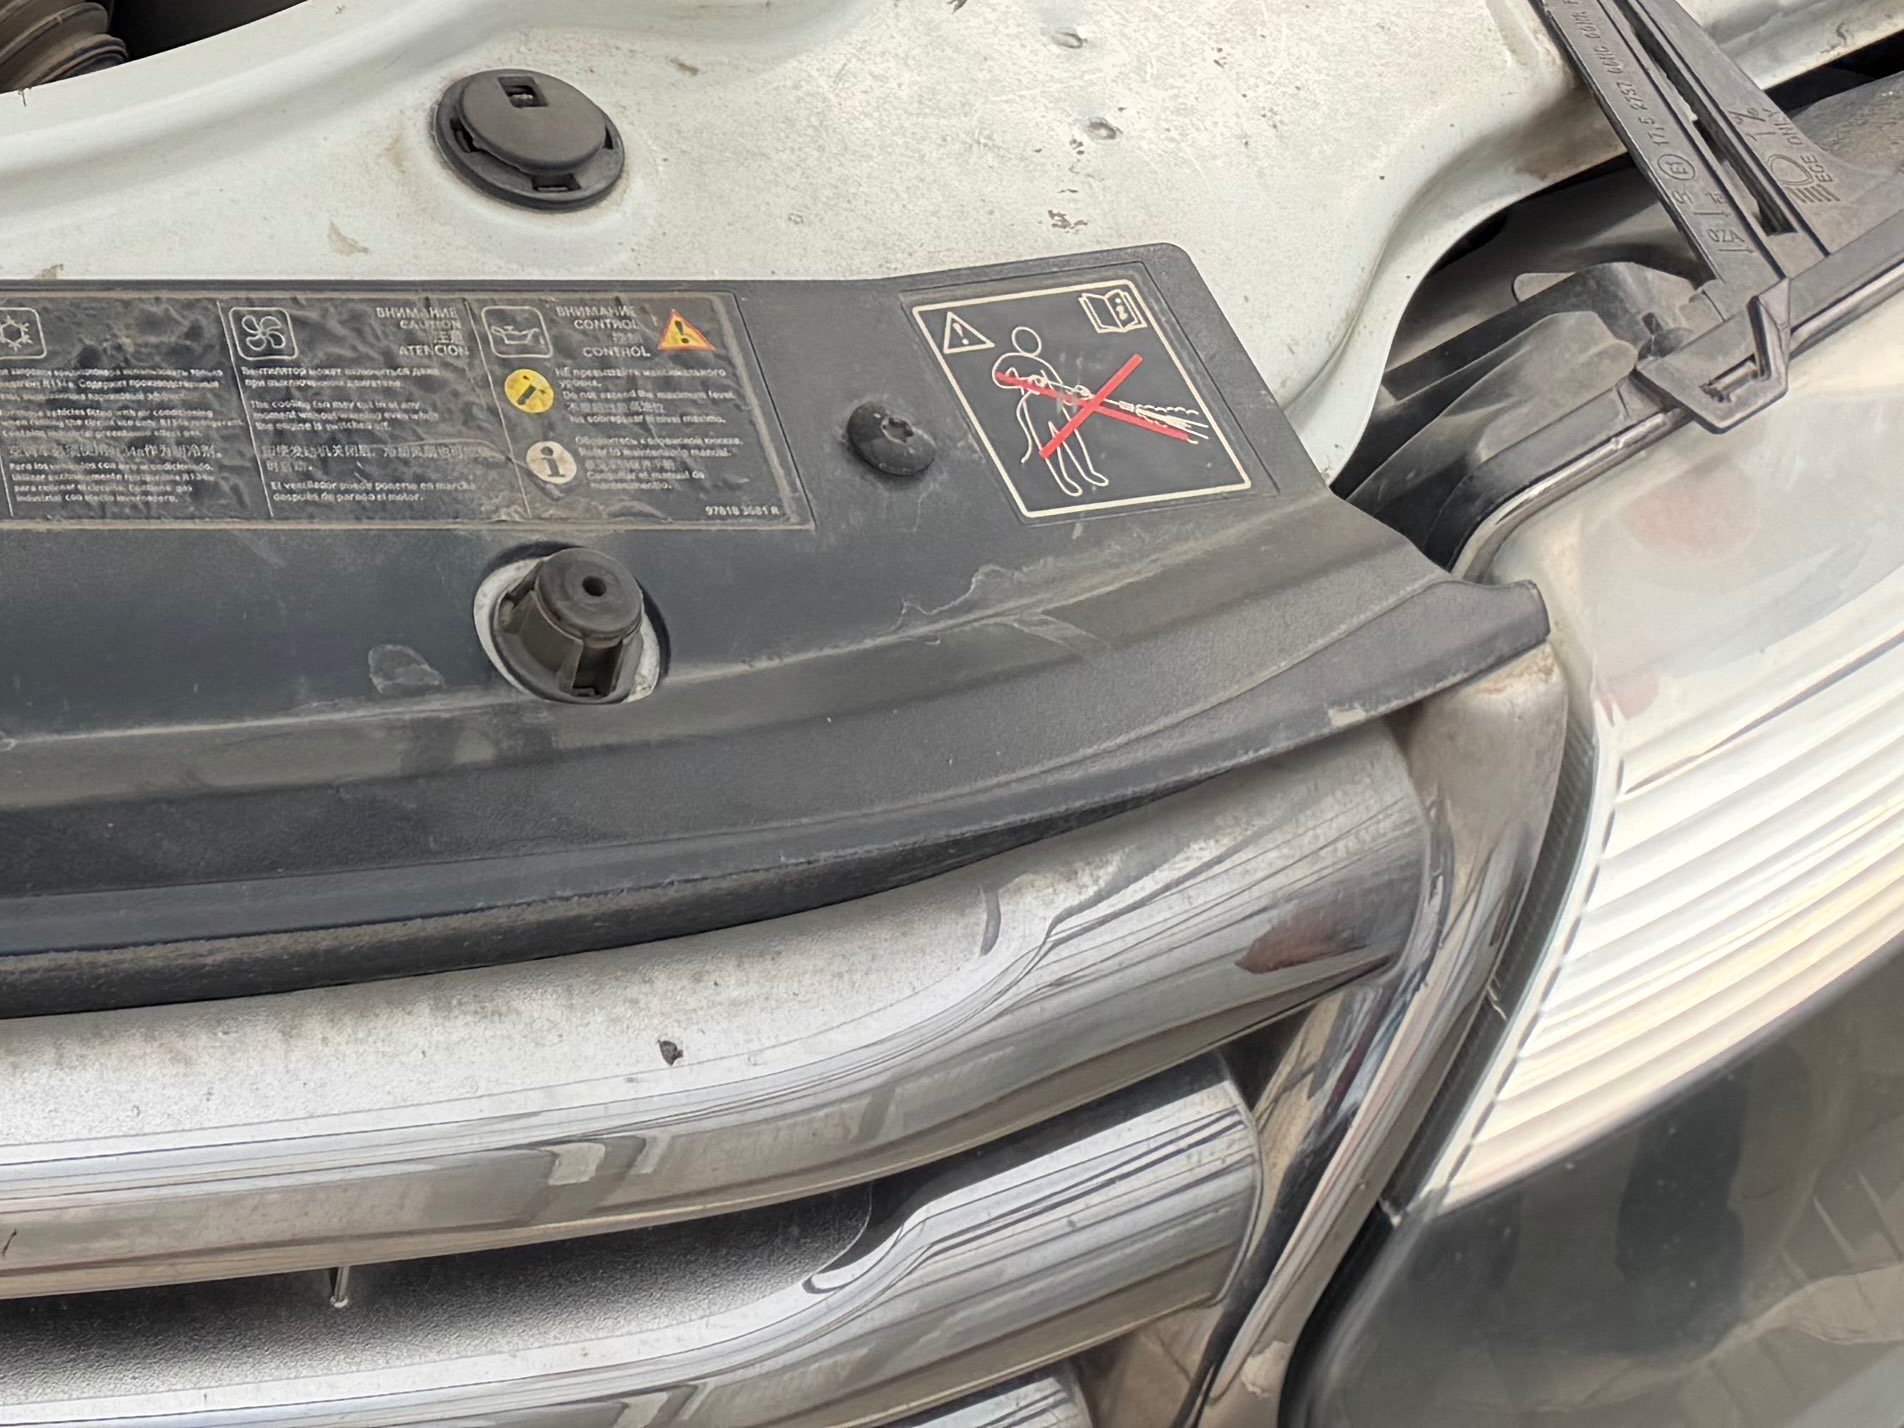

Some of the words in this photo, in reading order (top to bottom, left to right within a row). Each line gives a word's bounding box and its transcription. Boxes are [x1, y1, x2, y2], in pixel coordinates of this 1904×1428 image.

[1800, 154, 1833, 184] ECE
[400, 320, 462, 329] CAUTION
[573, 319, 640, 330] CONTROL
[583, 346, 651, 357] CONTROL
